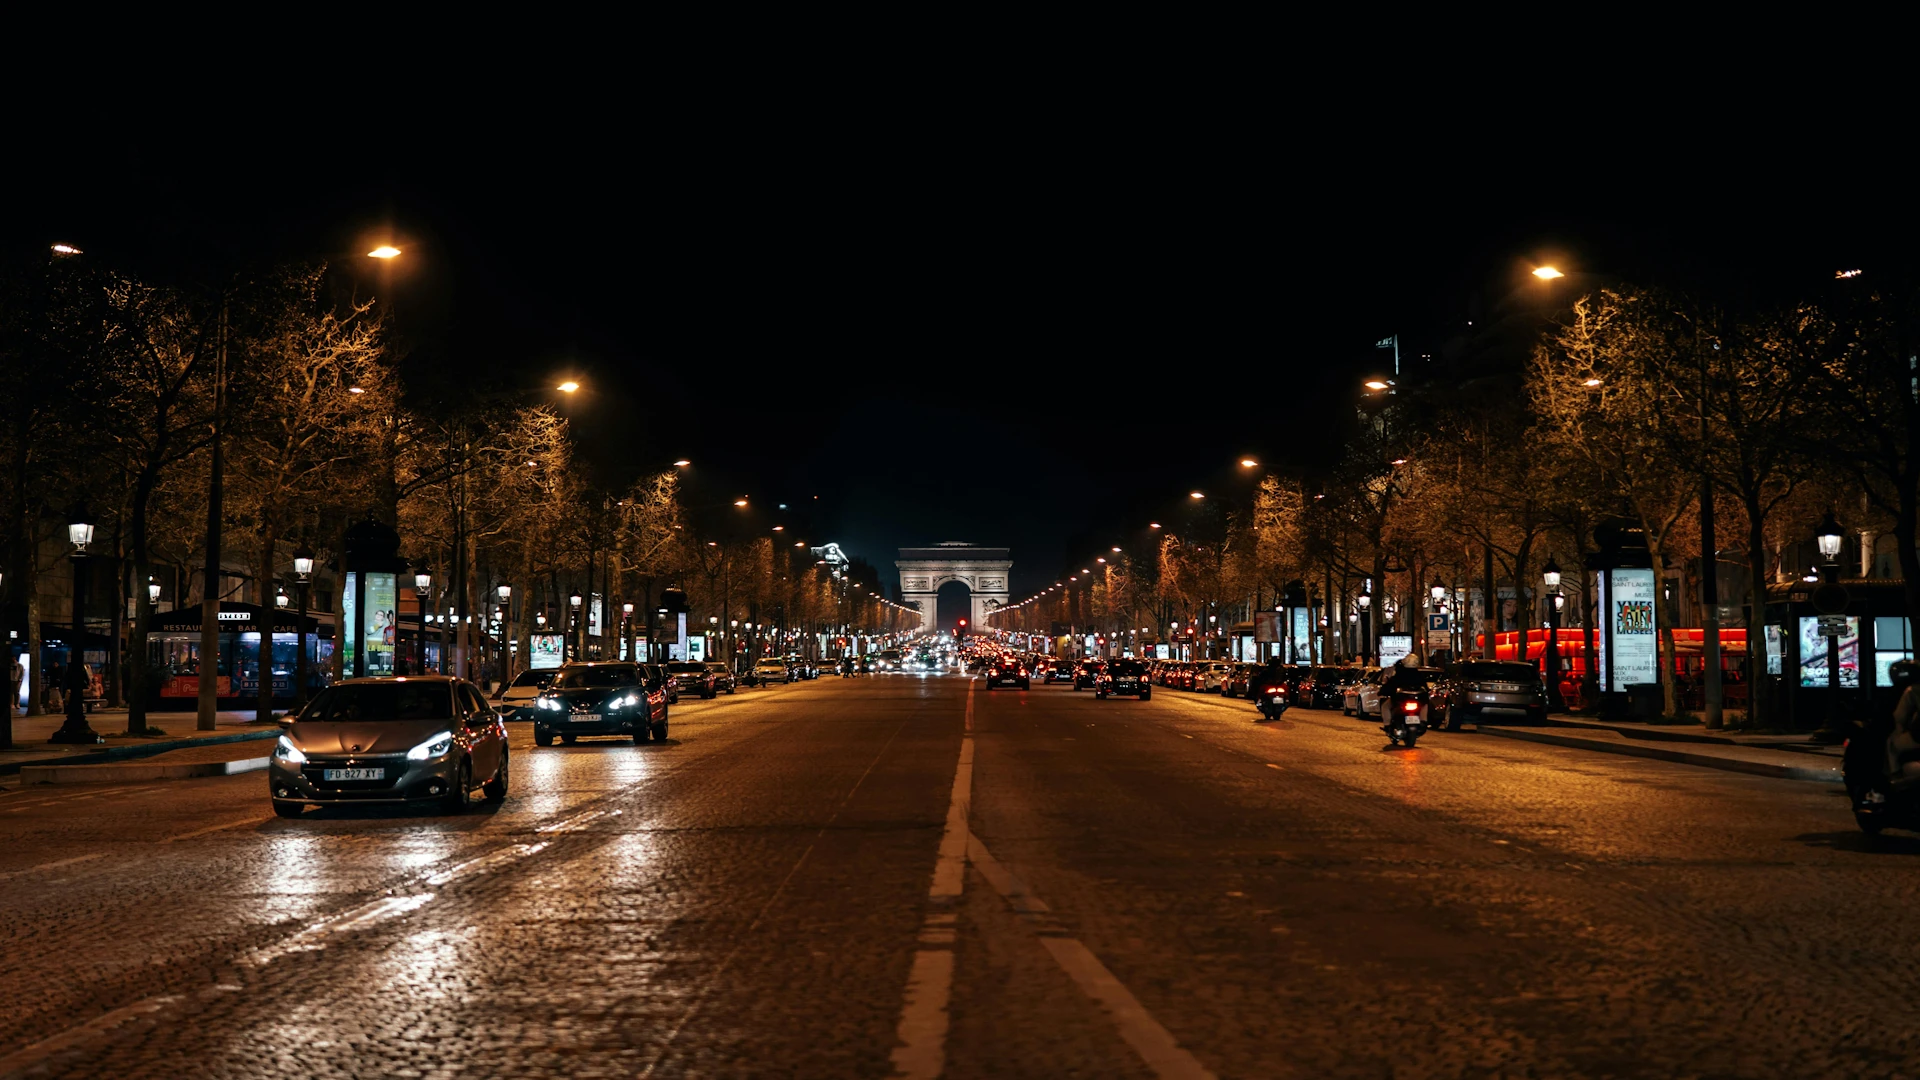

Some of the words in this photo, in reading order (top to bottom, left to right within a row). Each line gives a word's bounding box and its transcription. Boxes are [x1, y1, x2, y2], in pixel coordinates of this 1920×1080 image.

[1433, 616, 1444, 628] P
[163, 624, 225, 632] RESTAUT
[237, 624, 257, 632] BAR
